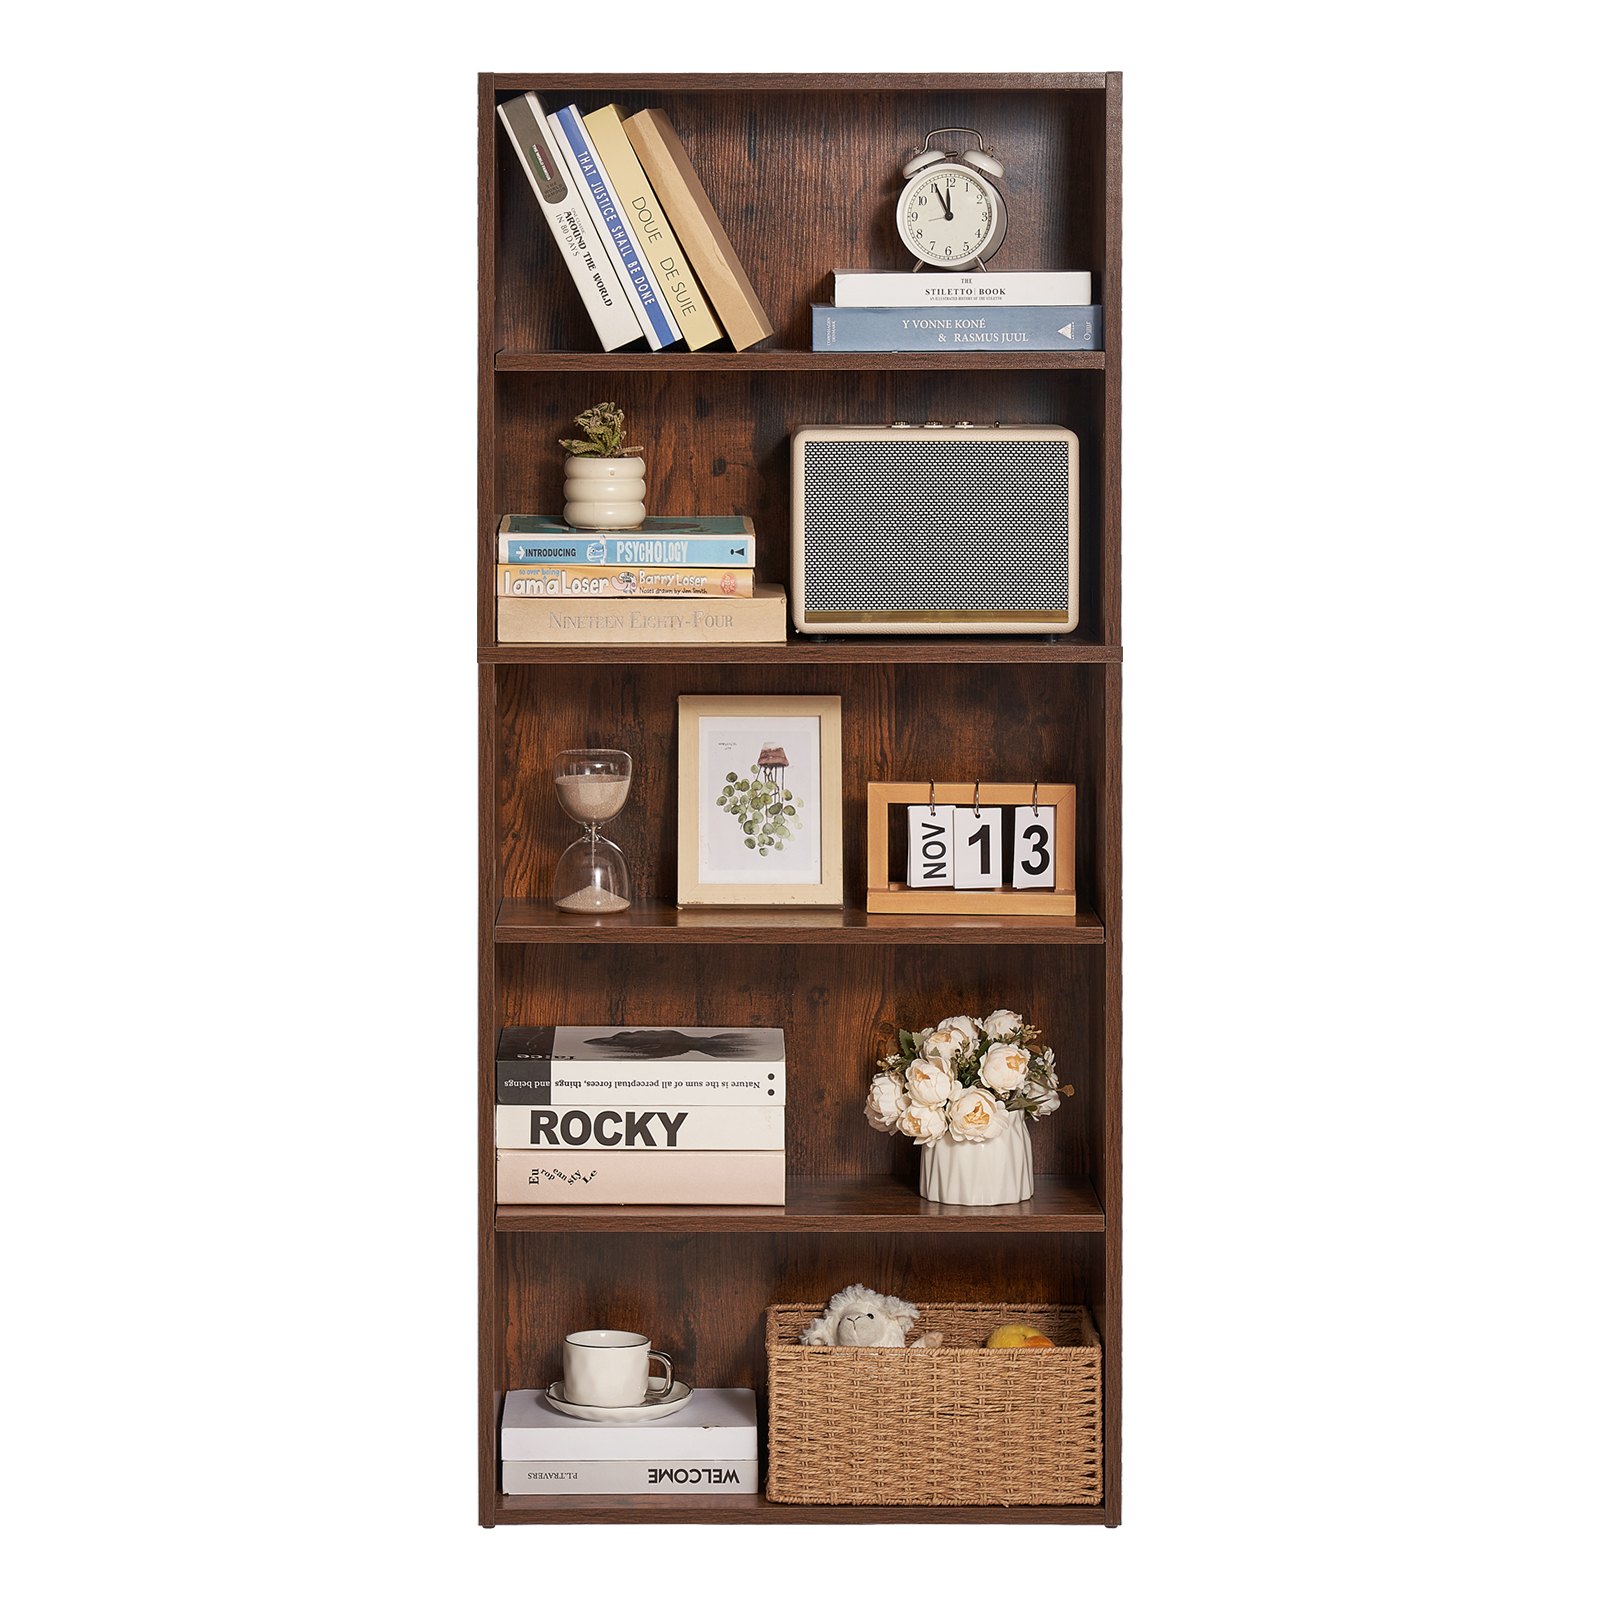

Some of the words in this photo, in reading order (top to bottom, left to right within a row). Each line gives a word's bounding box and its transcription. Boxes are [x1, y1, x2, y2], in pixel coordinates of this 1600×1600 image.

[946, 178, 956, 187] 12
[965, 182, 969, 192] 1
[918, 196, 927, 205] 10
[977, 195, 983, 204] 2
[911, 212, 918, 222] 9
[981, 212, 988, 222] 3
[577, 151, 596, 176] THAT
[591, 182, 617, 222] JUSTICE
[611, 225, 633, 257] SHALL
[627, 260, 641, 274] BE
[634, 276, 655, 306] DONE
[975, 229, 981, 238] 4
[556, 214, 564, 223] IN
[560, 224, 570, 234] 80
[565, 237, 580, 257] DAYS
[916, 229, 923, 239] 8
[929, 241, 936, 251] 7
[945, 246, 952, 256] 6
[963, 242, 969, 251] 5
[564, 211, 587, 249] AROUND
[583, 251, 597, 271] THE
[593, 272, 613, 306] WORLD
[632, 196, 662, 243] DOUE
[660, 257, 679, 281] DE
[671, 282, 696, 316] SUIE
[925, 288, 973, 296] STILETTO
[978, 288, 1007, 296] BOOK
[912, 320, 953, 329] VONNE
[954, 317, 986, 329] KONÉ
[938, 333, 946, 342] &
[954, 333, 999, 342] RASMUS
[1000, 333, 1029, 343] JUUL
[525, 548, 576, 557] INTRODUCING
[616, 541, 688, 563] PSYCHOLOGY
[541, 568, 560, 577] being
[504, 570, 511, 595] I
[513, 578, 543, 595] am
[546, 578, 559, 595] a
[561, 569, 609, 595] Loser
[639, 570, 675, 586] Barry
[676, 573, 708, 587] Loser
[674, 587, 681, 595] by
[922, 822, 946, 879] NOV
[968, 824, 990, 875] 1
[1021, 824, 1050, 875] 3
[504, 1079, 532, 1089] beings
[554, 1079, 582, 1088] things
[584, 1080, 612, 1089] forces,
[614, 1080, 659, 1089] perceptual
[662, 1081, 672, 1089] all
[673, 1081, 684, 1089] of
[706, 1081, 719, 1089] the
[721, 1081, 729, 1089] is
[731, 1081, 760, 1089] Nature
[530, 1110, 688, 1147] ROCKY
[648, 1469, 740, 1484] WELCOME
